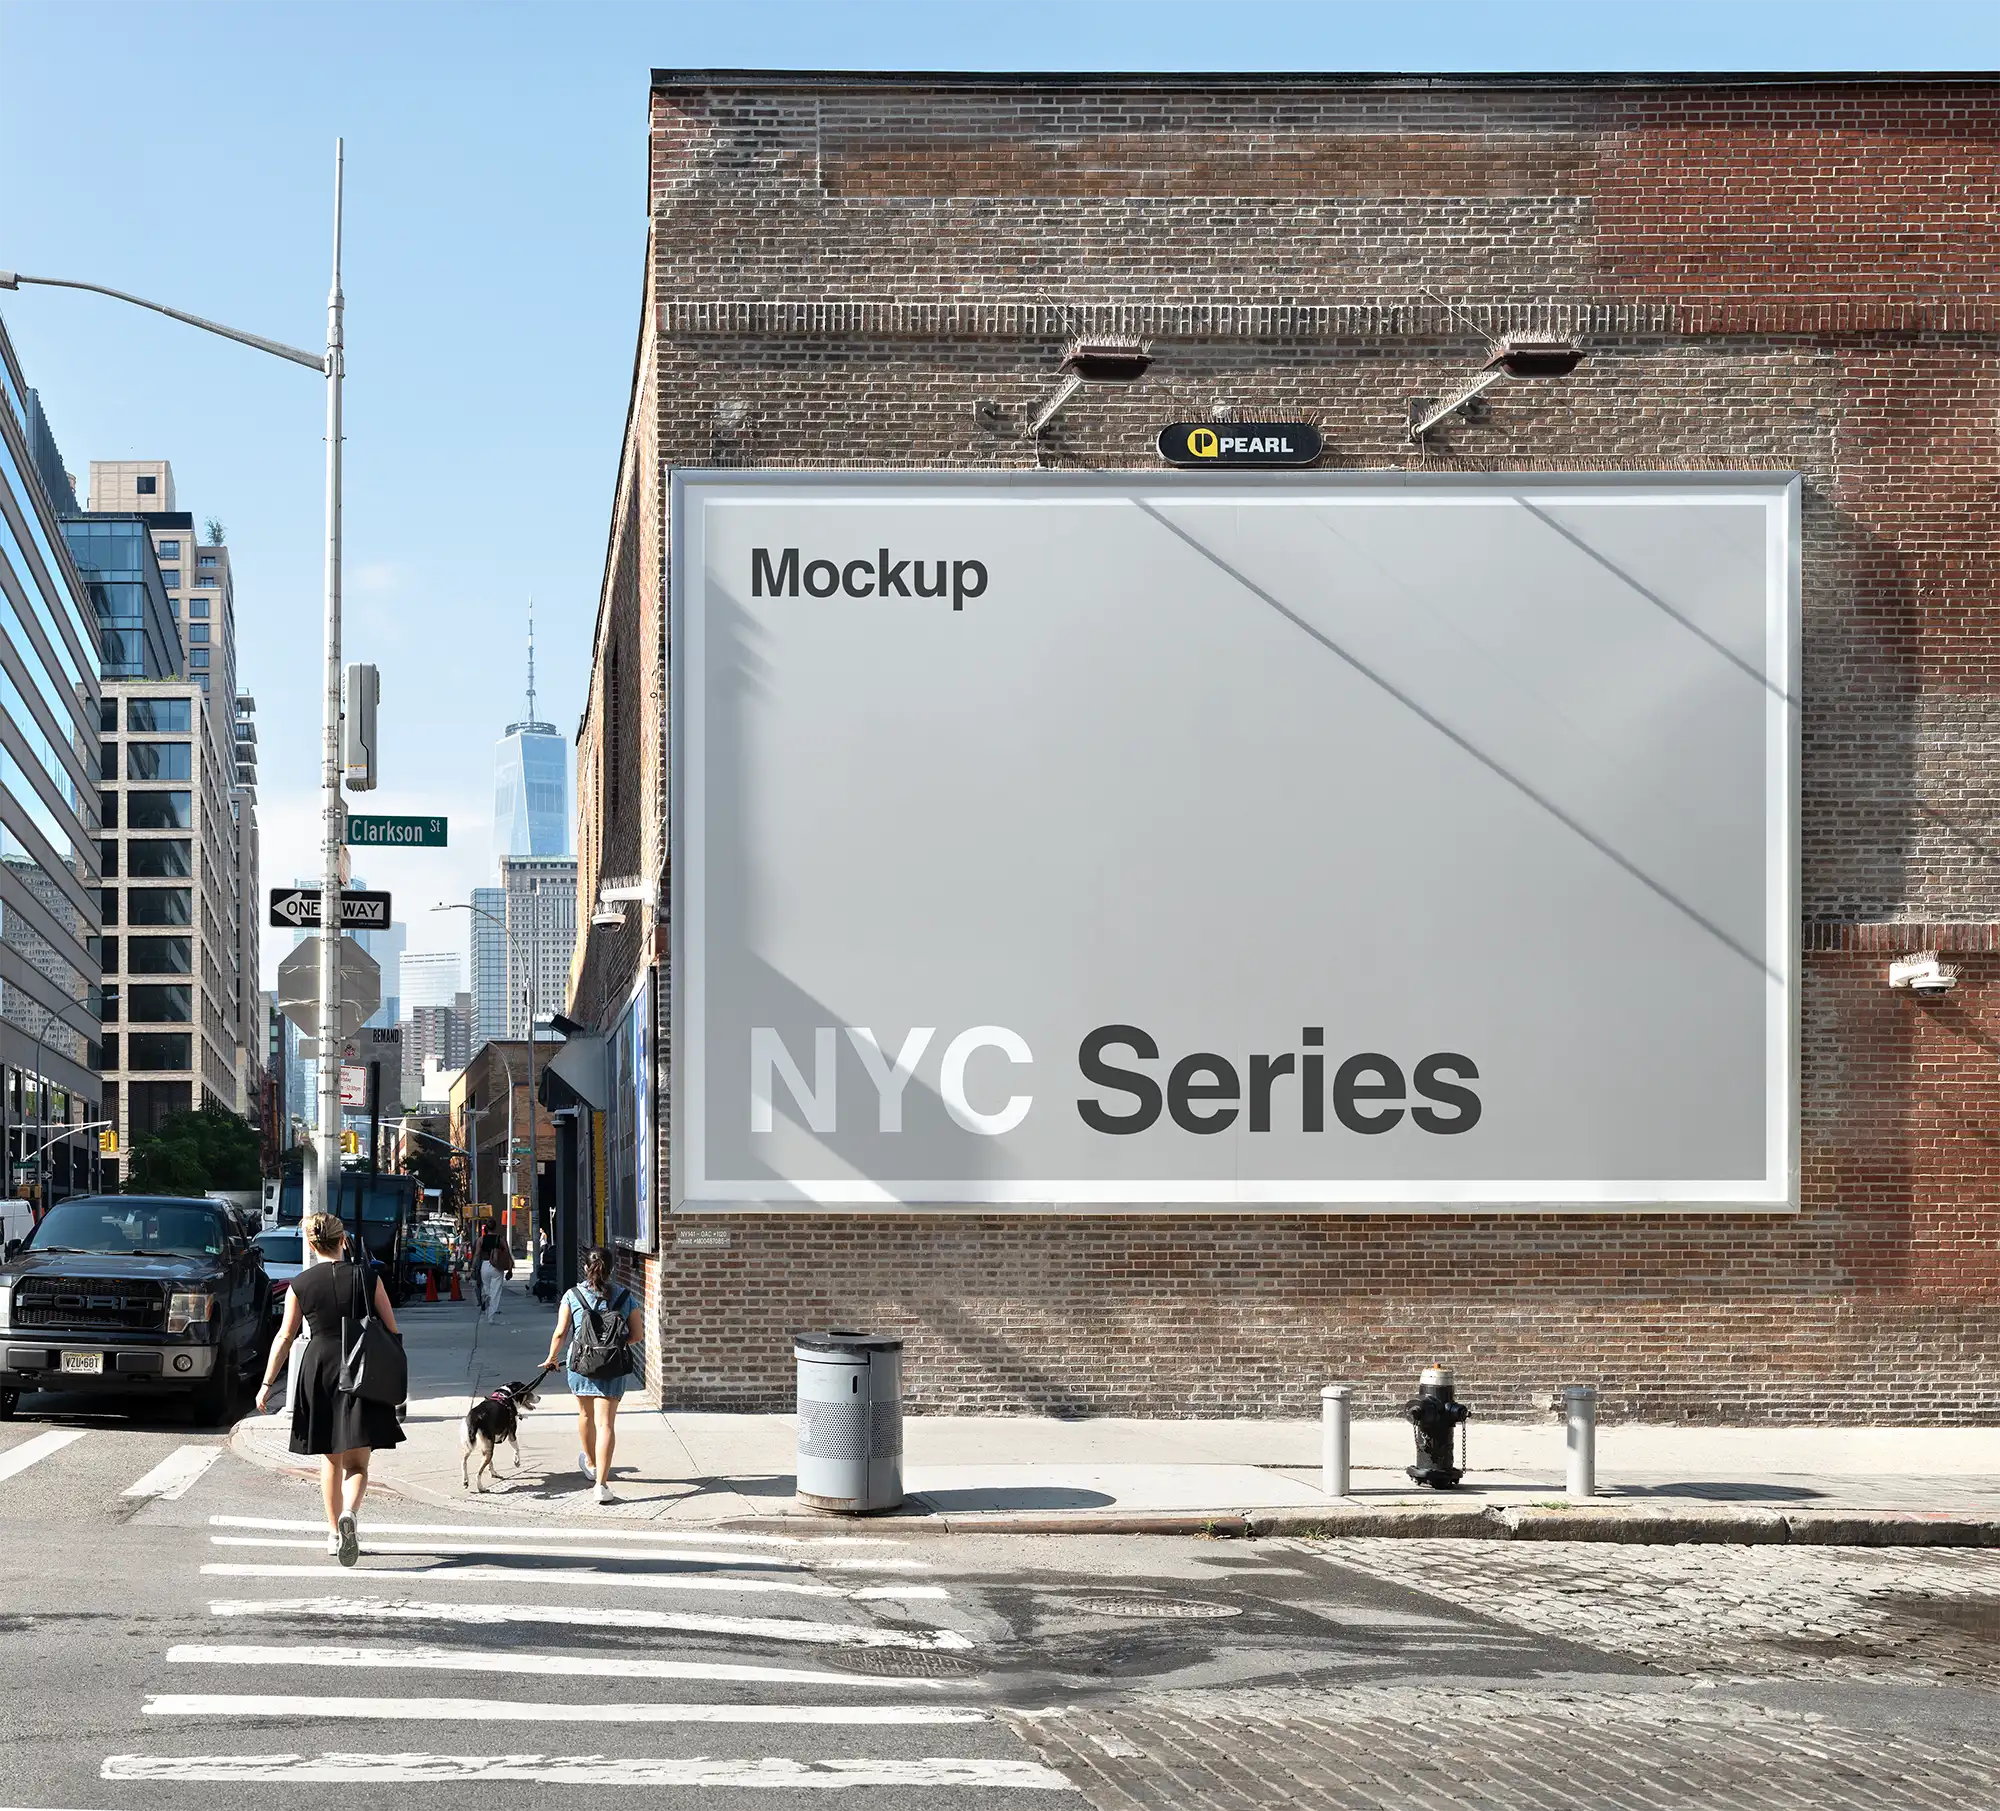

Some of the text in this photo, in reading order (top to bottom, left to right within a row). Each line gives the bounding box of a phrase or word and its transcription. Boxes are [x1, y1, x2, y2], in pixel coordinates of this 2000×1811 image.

[1219, 437, 1294, 453] PEARL
[752, 548, 988, 611] Mockup
[351, 819, 441, 842] Clarkson St
[286, 901, 379, 918] ONE WAY
[750, 1024, 1482, 1135] NYC Series
